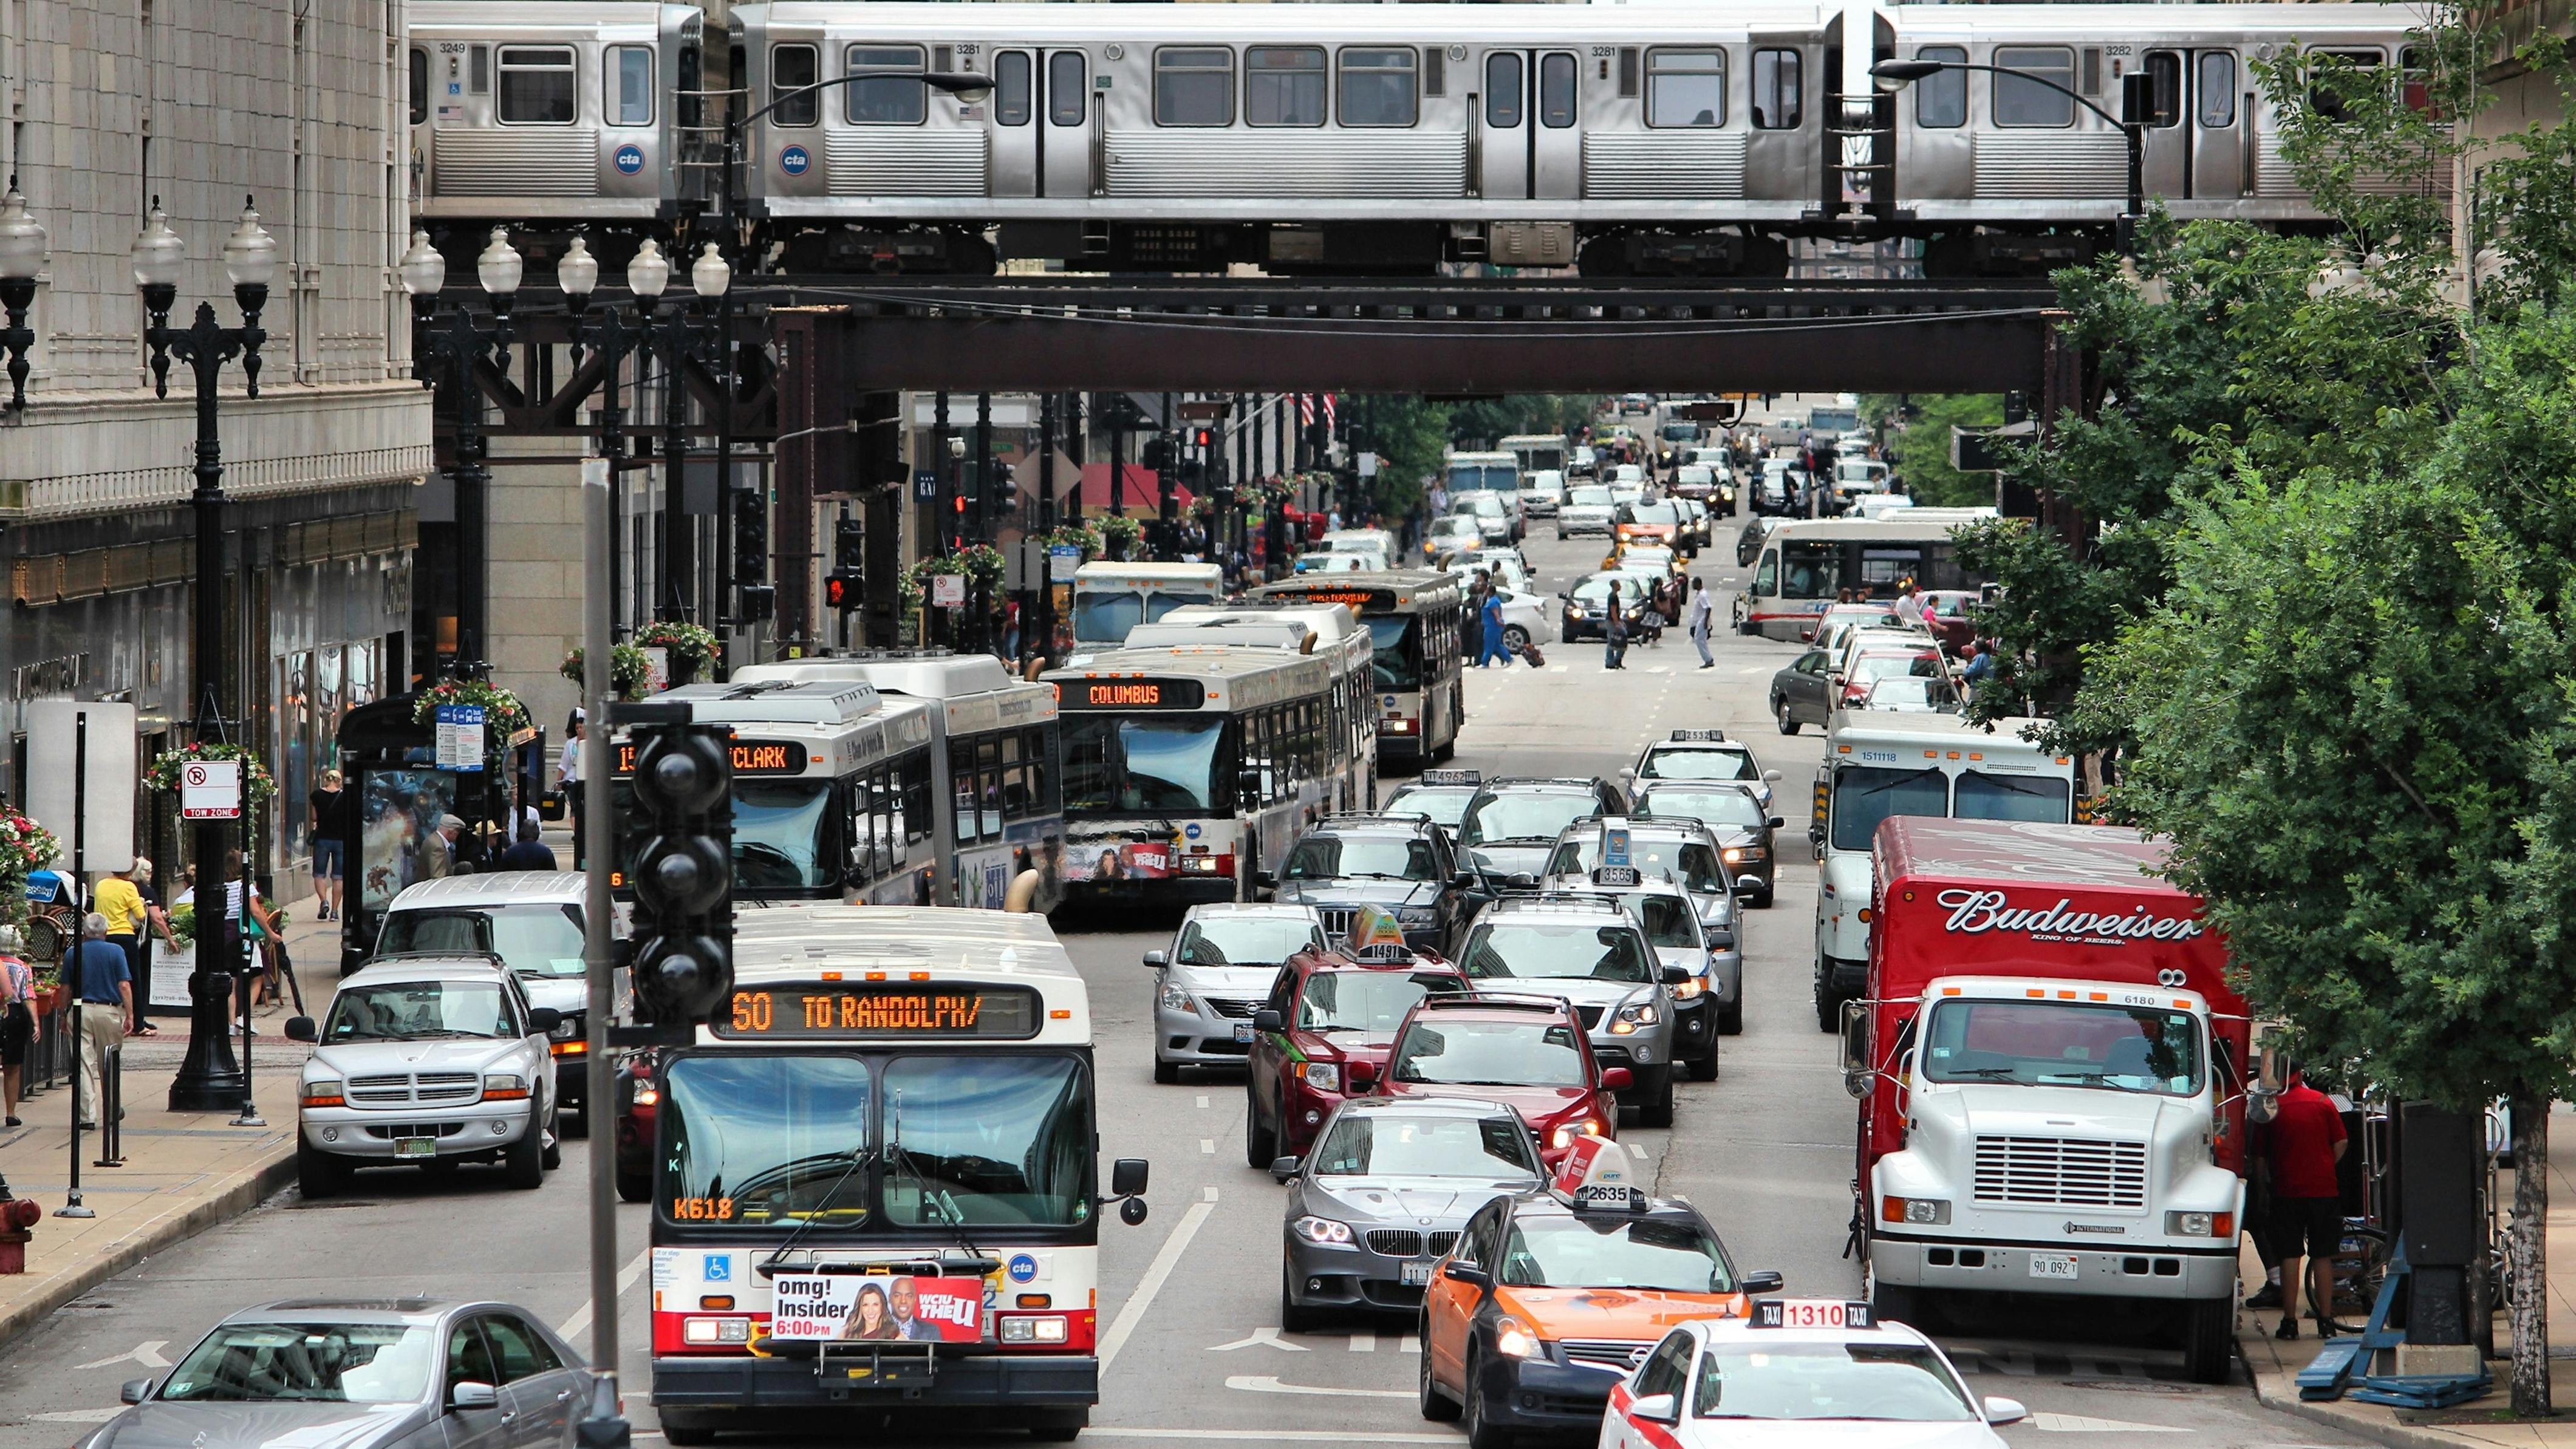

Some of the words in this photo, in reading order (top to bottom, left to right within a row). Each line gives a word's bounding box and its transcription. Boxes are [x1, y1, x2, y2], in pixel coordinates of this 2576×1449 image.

[440, 43, 465, 53] 3249
[957, 44, 980, 55] 3281
[1592, 46, 1616, 56] 3281
[2106, 46, 2131, 56] 3282
[619, 154, 640, 165] cta
[784, 154, 805, 165] cta
[1090, 686, 1158, 704] COLUMBUS
[1686, 731, 1709, 740] 2532
[1862, 751, 1897, 762] 1511118
[1438, 772, 1464, 782] 4962
[1604, 868, 1631, 882] 3565
[1936, 888, 2202, 941] Budweiser
[1374, 945, 1397, 958] 1491
[2125, 995, 2155, 1005] 6180
[802, 997, 832, 1028] TO
[841, 996, 982, 1028] RANDOLPH/
[1589, 1186, 1627, 1201] 2635
[674, 1198, 733, 1219] K618
[2076, 1225, 2125, 1233] INTERNATIONAL
[1012, 1263, 1033, 1273] cta
[2034, 1261, 2045, 1273] 90
[2051, 1261, 2068, 1273] 092
[778, 1280, 831, 1299] omg!
[918, 1294, 953, 1305] WCIU
[777, 1300, 849, 1318] Insider
[920, 1305, 954, 1319] THE
[951, 1297, 977, 1328] U
[1763, 1306, 1781, 1325] TAXI
[1789, 1306, 1843, 1326] 1310
[1848, 1307, 1867, 1326] TAXI
[776, 1320, 830, 1335] 6:00PM
